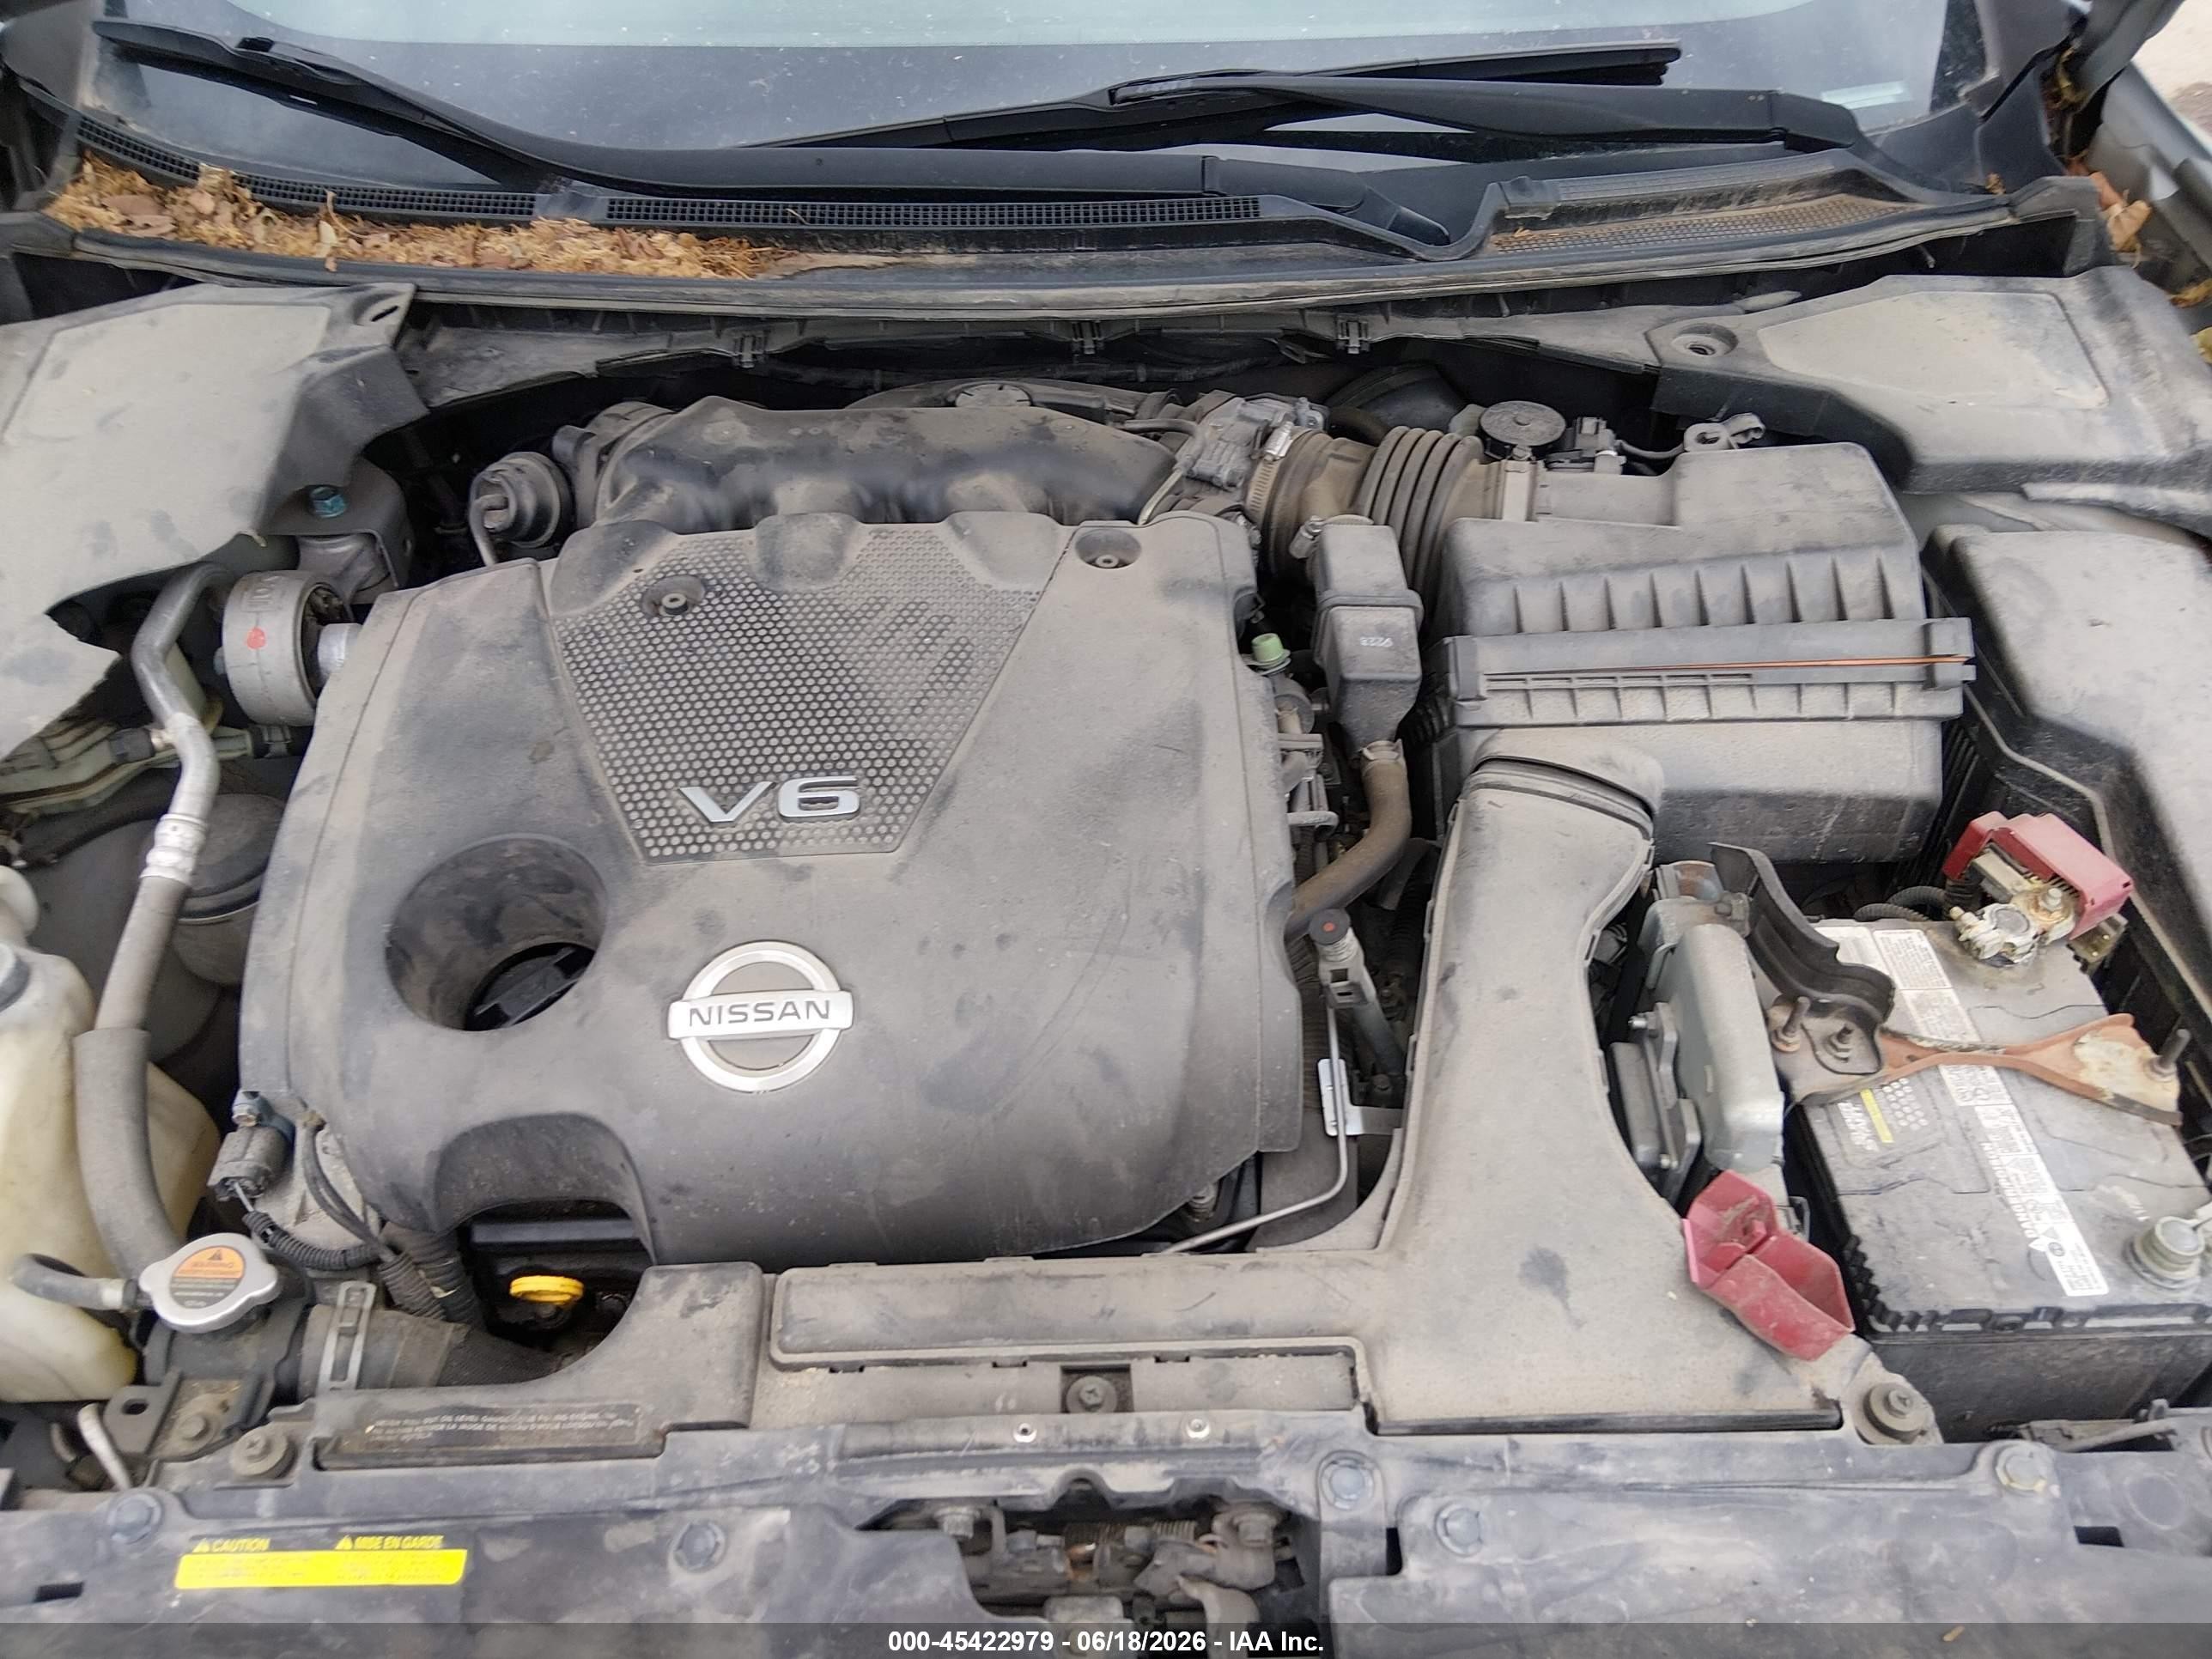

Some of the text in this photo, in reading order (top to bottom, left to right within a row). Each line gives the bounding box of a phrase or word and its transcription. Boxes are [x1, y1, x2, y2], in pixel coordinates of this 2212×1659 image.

[678, 776, 860, 823] V6
[689, 1000, 831, 1028] NISSAN
[212, 1538, 271, 1553] CAUTION
